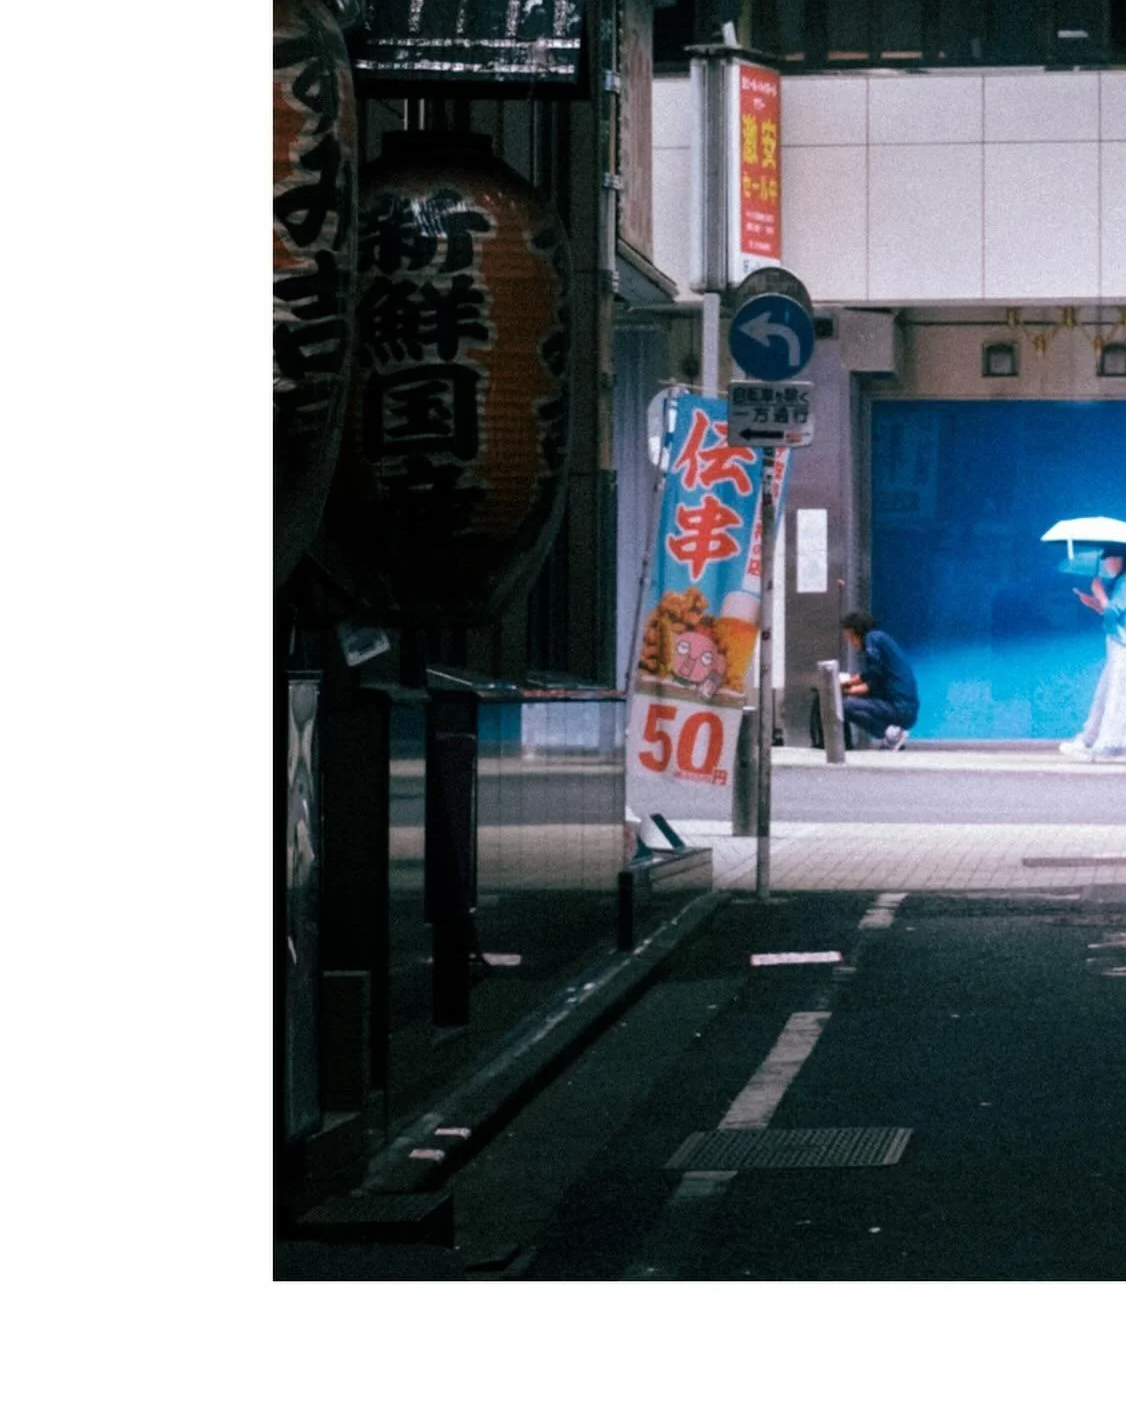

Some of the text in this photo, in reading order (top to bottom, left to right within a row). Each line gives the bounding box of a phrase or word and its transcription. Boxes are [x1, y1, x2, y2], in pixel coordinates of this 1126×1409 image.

[732, 406, 810, 424] 一方通行
[668, 407, 757, 582] 伝串
